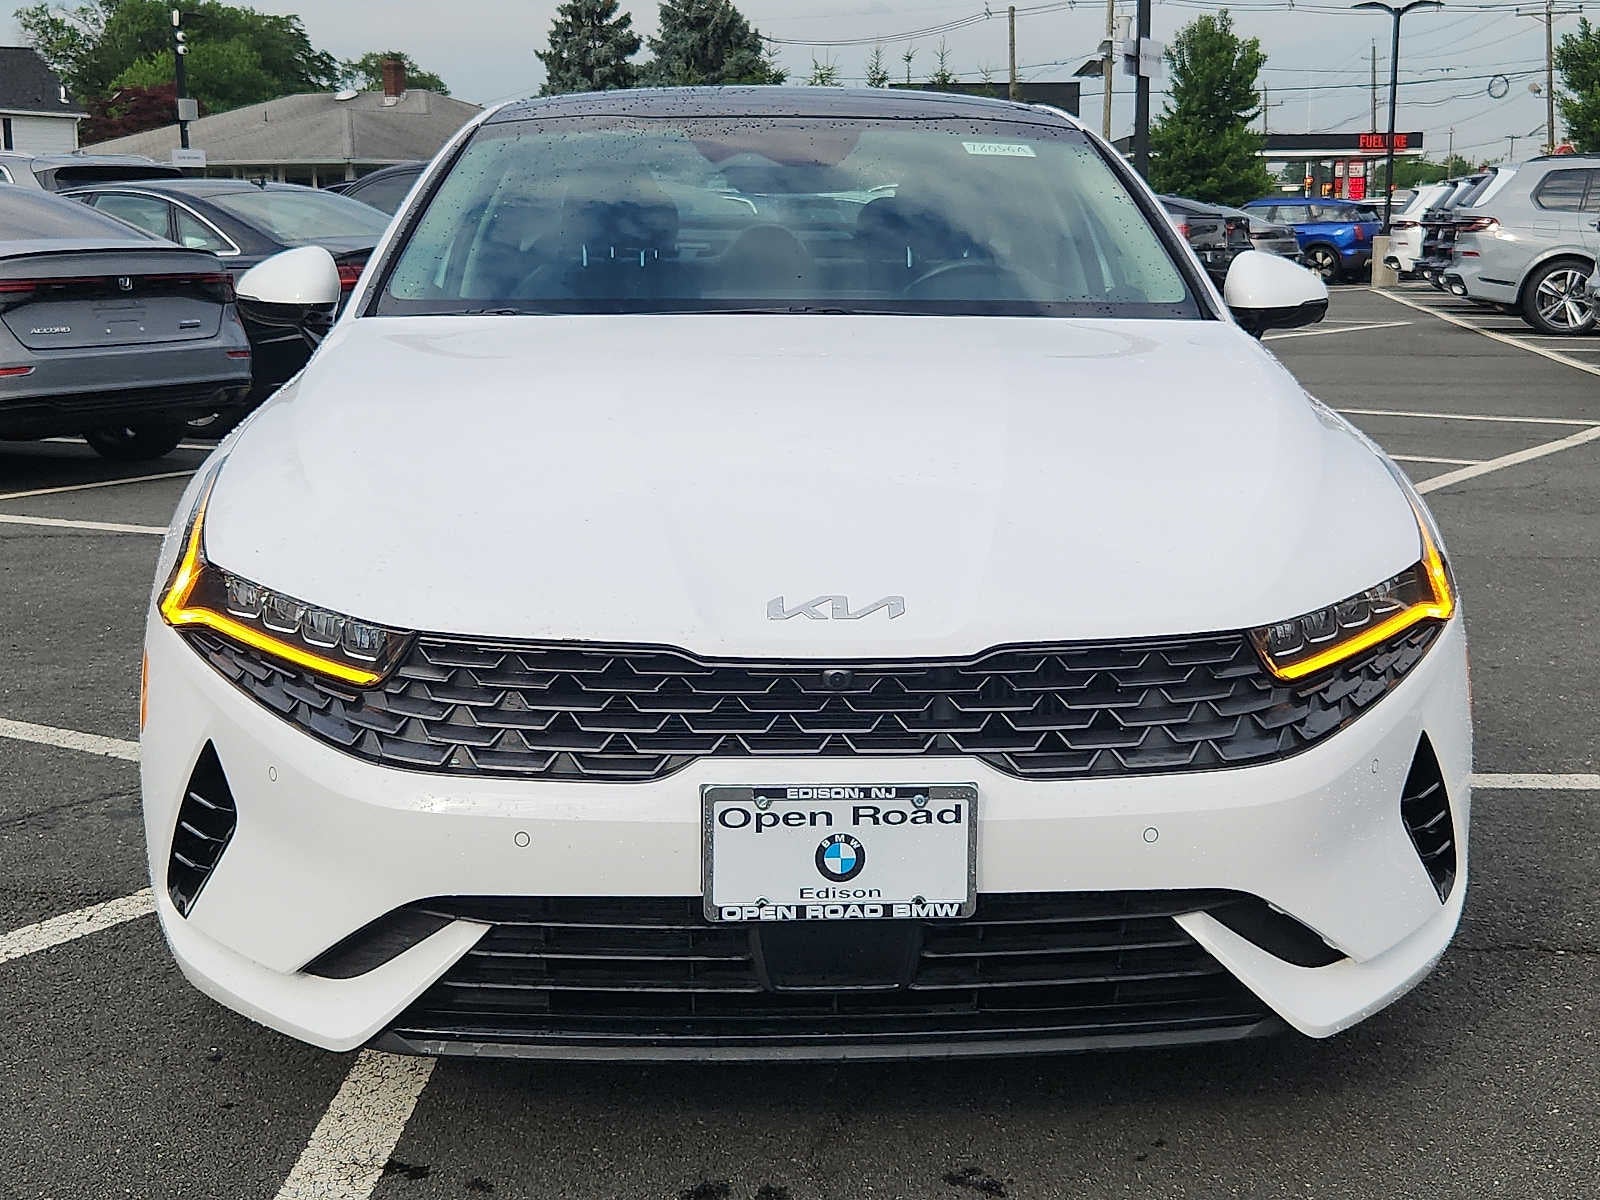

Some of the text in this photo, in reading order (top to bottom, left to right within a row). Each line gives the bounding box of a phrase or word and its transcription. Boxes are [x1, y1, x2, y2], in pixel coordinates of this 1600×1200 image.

[30, 326, 72, 334] ACCORD
[767, 595, 905, 620] KIA
[870, 787, 896, 799] NJ
[718, 804, 962, 833] Open Road
[821, 834, 861, 848] BMW
[799, 887, 881, 899] Edison
[721, 903, 959, 920] OPEN ROAD BMW
